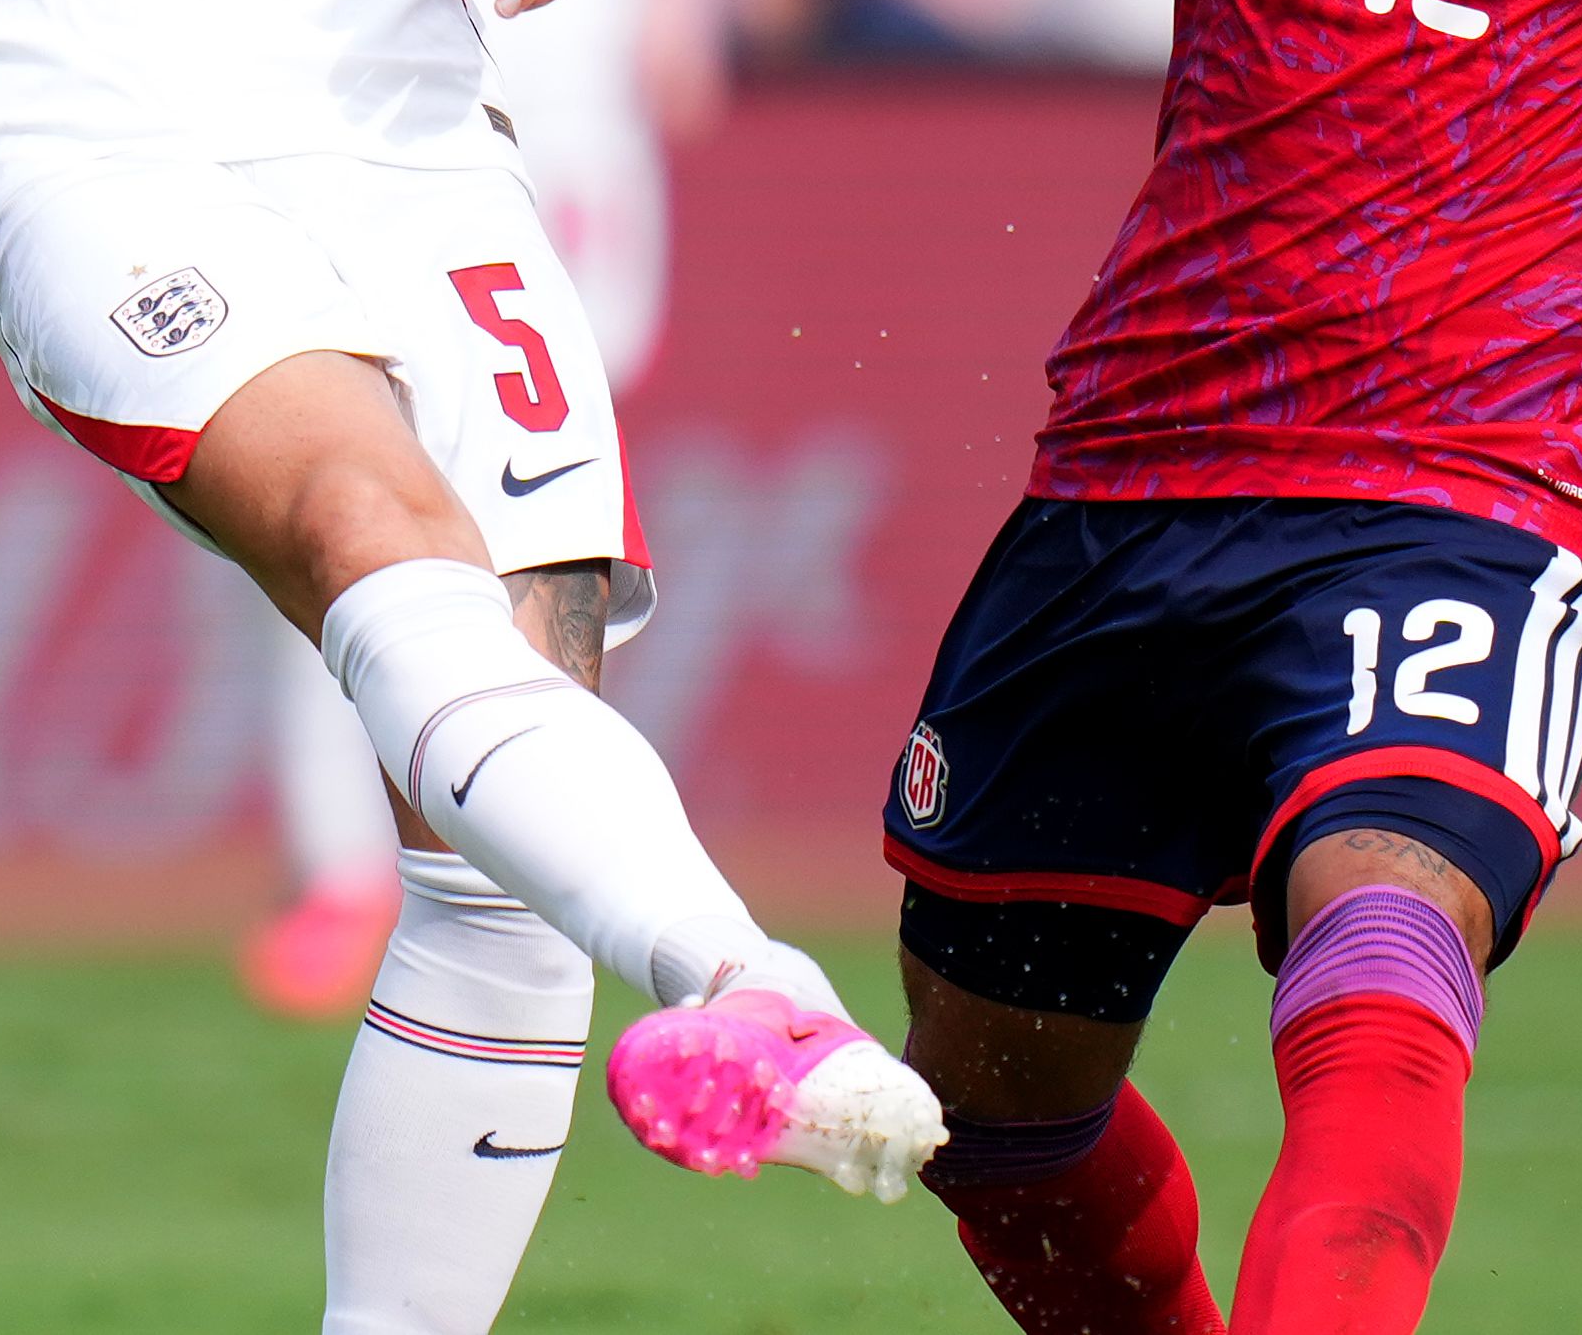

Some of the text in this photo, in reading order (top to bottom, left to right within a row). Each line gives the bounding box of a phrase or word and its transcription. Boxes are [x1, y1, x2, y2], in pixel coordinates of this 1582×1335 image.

[447, 262, 570, 433] 5
[1343, 598, 1495, 736] 12
[907, 742, 937, 811] CR
